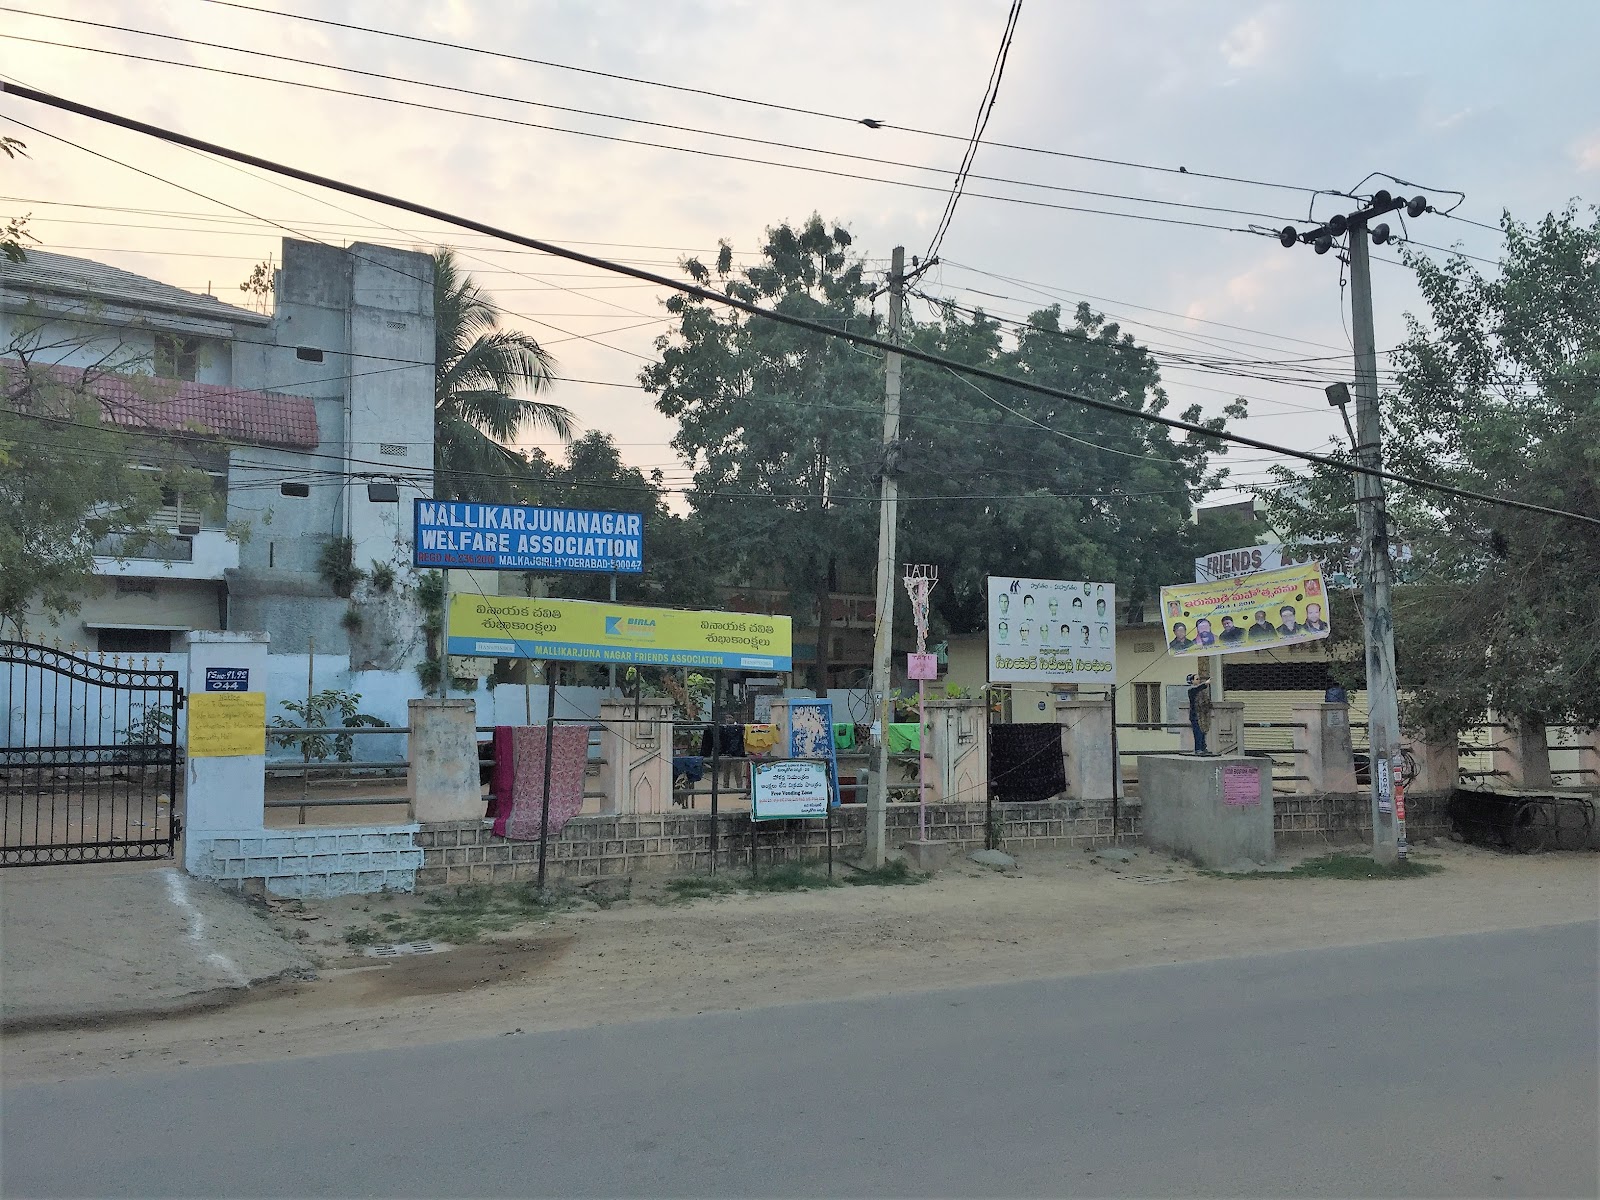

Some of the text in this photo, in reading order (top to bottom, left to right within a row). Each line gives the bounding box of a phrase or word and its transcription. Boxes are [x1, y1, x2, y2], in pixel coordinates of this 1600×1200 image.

[420, 502, 640, 536] MALLIKARJUNANAGAR
[422, 529, 638, 558] WELFARE ASSOCIATION
[903, 563, 939, 579] TATU
[1207, 549, 1262, 575] FRIENDS
[476, 604, 562, 619] వినాయక చవితి
[481, 618, 557, 636] శుభాకాంక్షలు
[627, 618, 656, 626] BIRLA
[700, 620, 775, 634] వినాయక చవితి
[705, 632, 770, 650] శుభాకాంక్షలు
[535, 645, 723, 665] MALLIKARJUNA NAGAR FRIENDS ASSOCIATION
